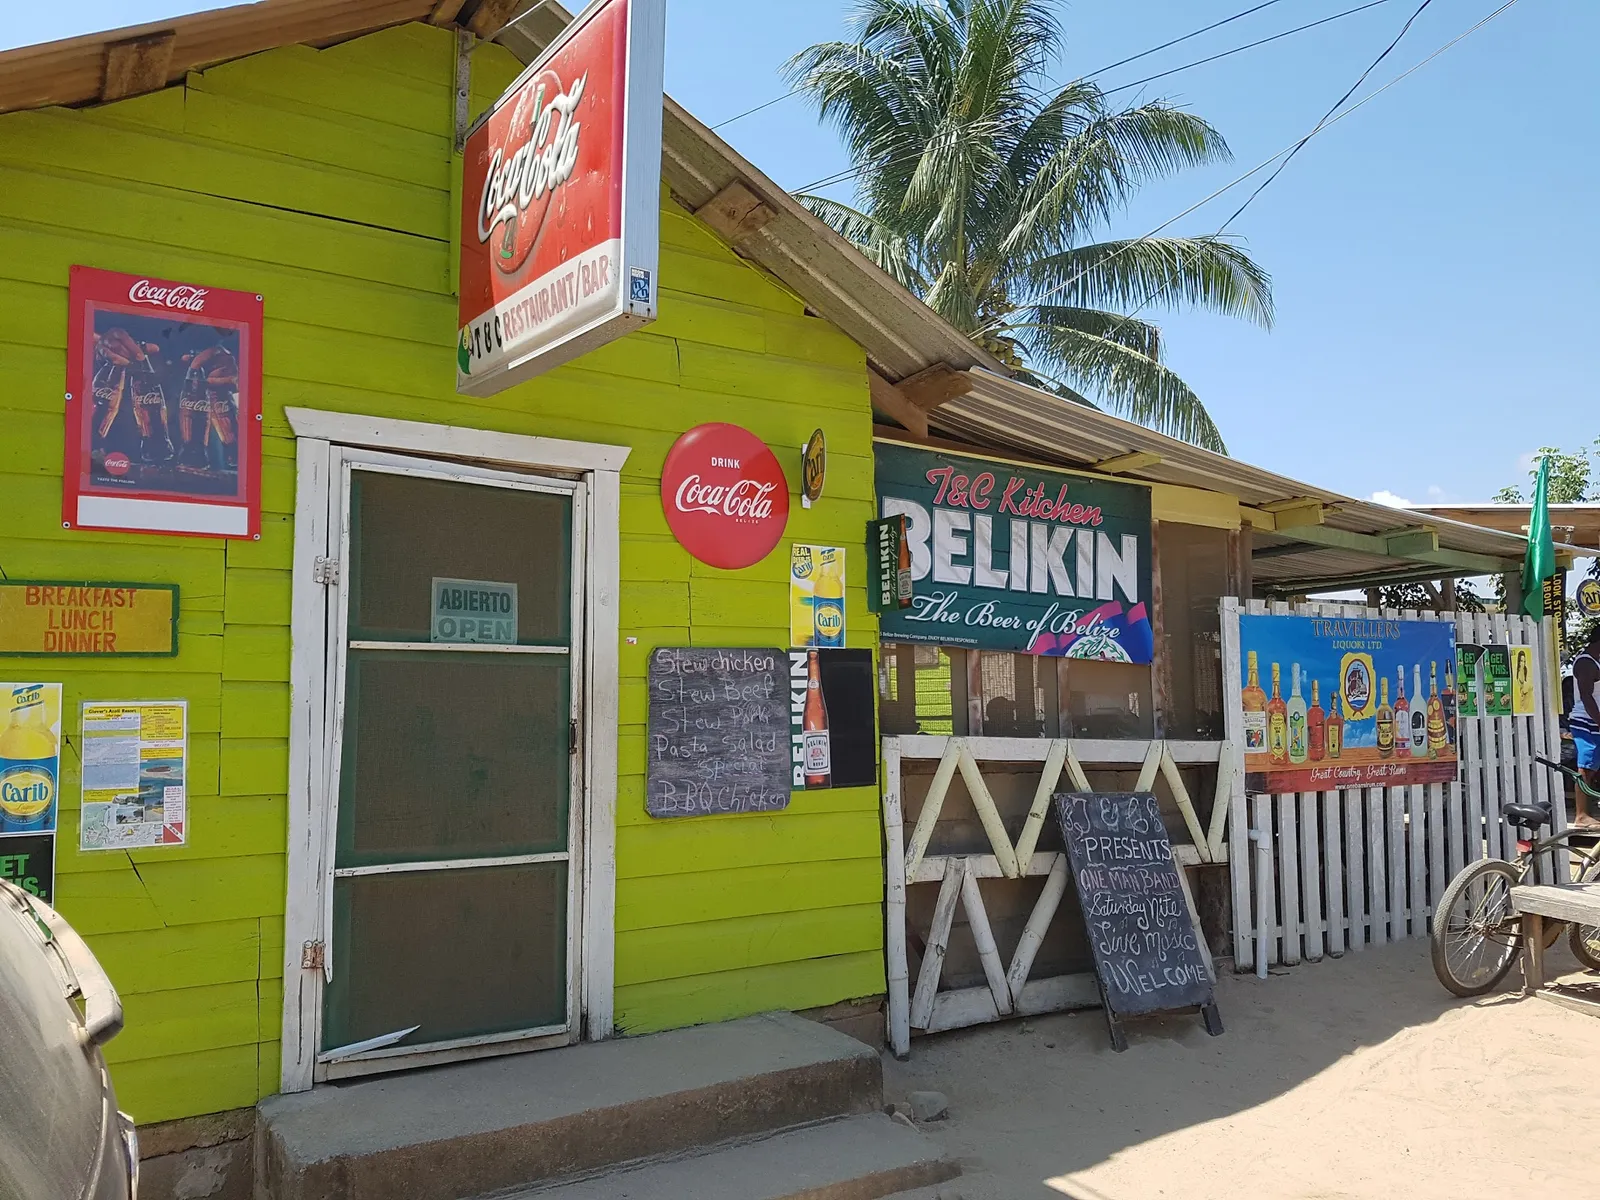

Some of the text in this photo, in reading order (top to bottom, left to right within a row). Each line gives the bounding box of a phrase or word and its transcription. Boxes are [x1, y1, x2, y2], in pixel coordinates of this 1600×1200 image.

[478, 68, 588, 243] Coca-Cola
[128, 279, 210, 312] Coca-Cola
[711, 457, 740, 469] DRINK
[675, 474, 778, 519] Coca-Cola
[925, 465, 1103, 527] T&C Kitchen
[882, 496, 1138, 604] BELIKIN
[879, 524, 891, 605] BELIKIN
[25, 585, 137, 608] BREAKFAST
[439, 588, 511, 614] ABIERTO
[1543, 580, 1552, 610] ABOUT
[48, 608, 114, 631] LUNCH
[438, 617, 512, 640] OPEN
[817, 614, 841, 628] Carib
[904, 591, 1120, 655] The Beer of Belize
[1311, 619, 1401, 639] TRAVELLERS
[43, 631, 117, 653] DINNER
[1332, 640, 1365, 650] LIQUORS
[656, 649, 775, 676] Stew chicken
[1490, 654, 1503, 664] GET
[16, 691, 40, 704] Carib
[658, 673, 774, 704] Stew Beef
[661, 706, 722, 733] Stew
[653, 731, 777, 760] Pasta Salad
[1310, 767, 1333, 782] Great
[1334, 766, 1362, 781] Country,
[1366, 764, 1387, 779] Great
[2, 782, 49, 802] Carib
[656, 778, 787, 814] BBQ Chicken
[1081, 837, 1172, 862] PRESENTS
[1080, 868, 1180, 894] ONE MAN BAND
[1089, 893, 1181, 929] Saturday Nite
[1095, 921, 1196, 962] Live Music
[1103, 959, 1207, 996] WELCOME
